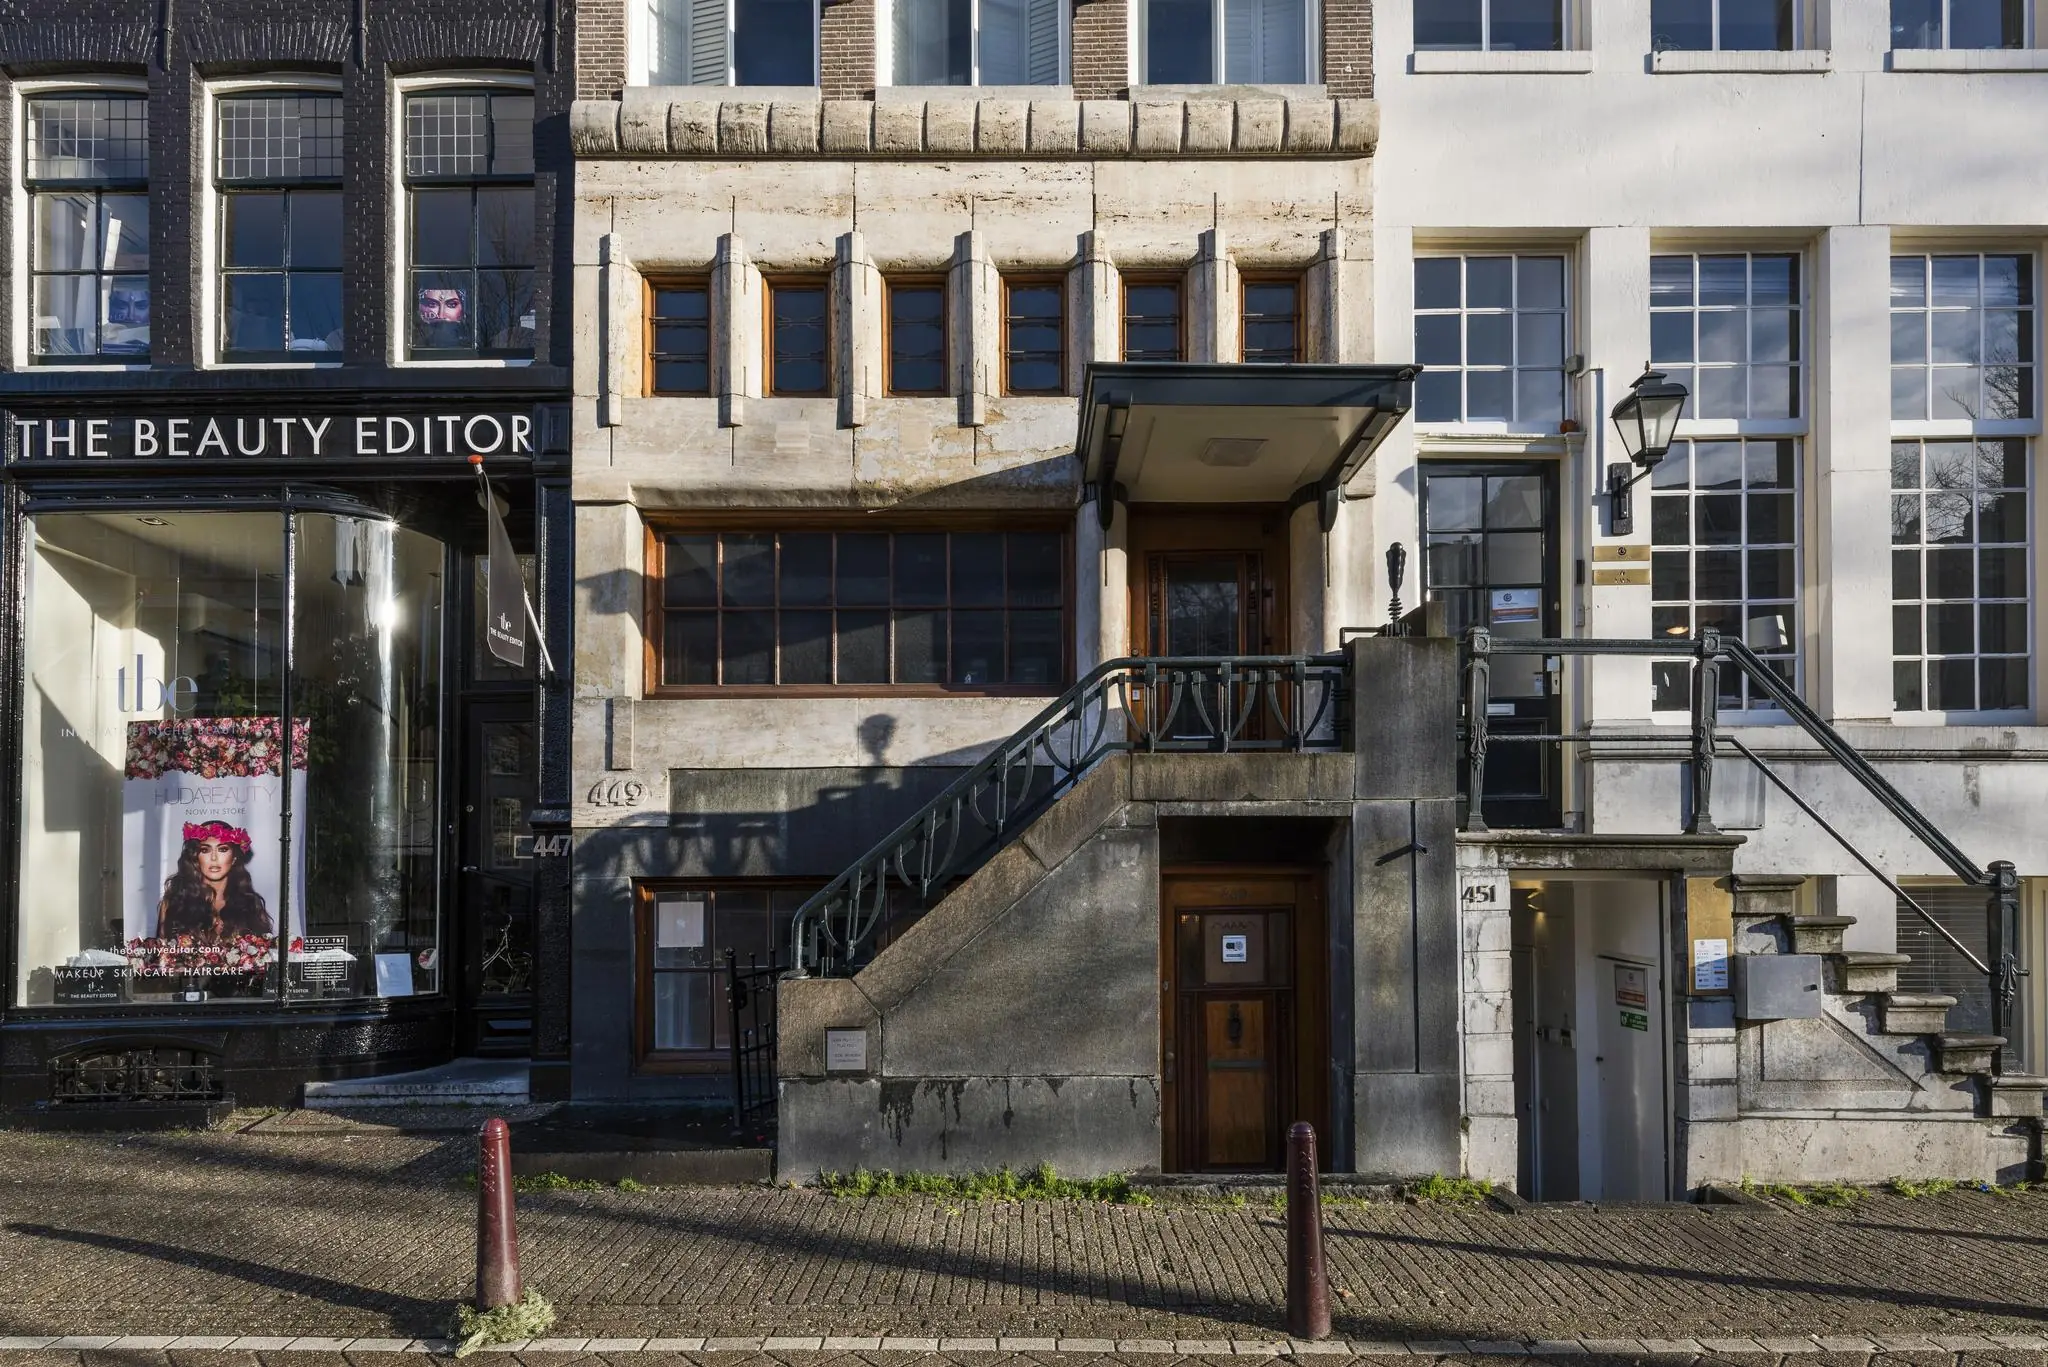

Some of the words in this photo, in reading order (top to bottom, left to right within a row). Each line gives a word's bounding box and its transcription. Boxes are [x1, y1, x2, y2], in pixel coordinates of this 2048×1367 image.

[14, 419, 109, 457] THE
[134, 416, 331, 456] BEAUTY
[356, 414, 533, 454] EDITOR
[114, 654, 199, 712] tbe
[587, 777, 649, 807] 449
[533, 835, 572, 857] 447
[1461, 885, 1496, 903] 451
[55, 969, 105, 978] MAKEUP
[114, 968, 174, 977] SKINCARE
[184, 967, 244, 976] HAIRCARE
